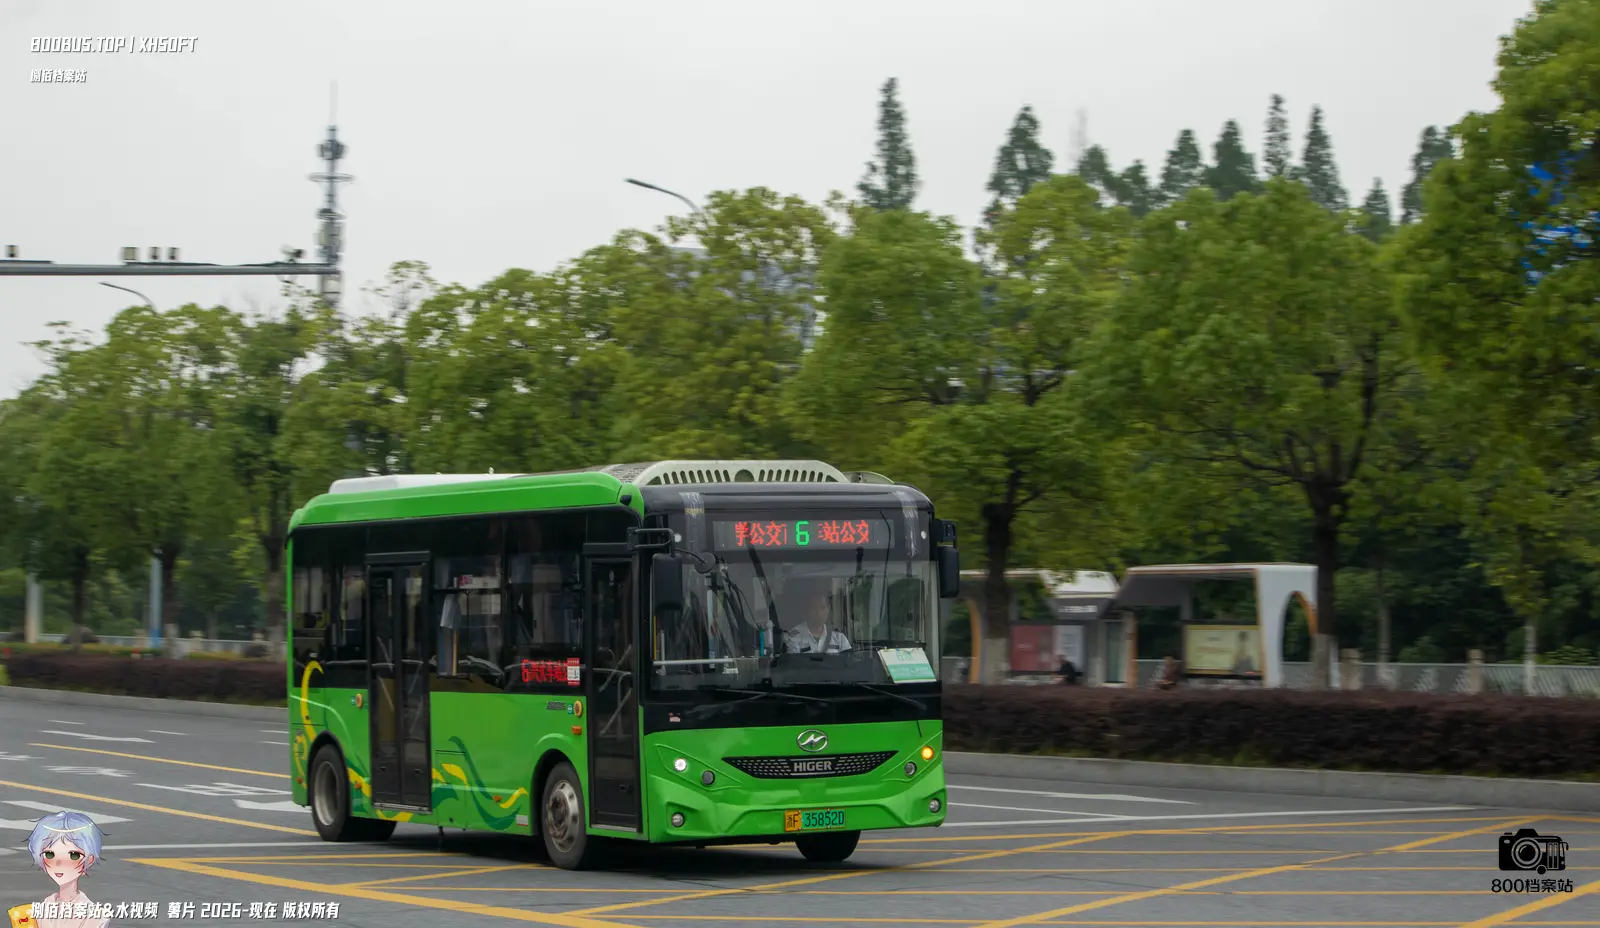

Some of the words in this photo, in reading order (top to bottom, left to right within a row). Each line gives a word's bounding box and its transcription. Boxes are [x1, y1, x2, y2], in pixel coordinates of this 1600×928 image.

[735, 520, 787, 546] 学公交
[795, 520, 810, 546] 6
[793, 760, 832, 773] HIGER
[804, 811, 845, 827] 35852D
